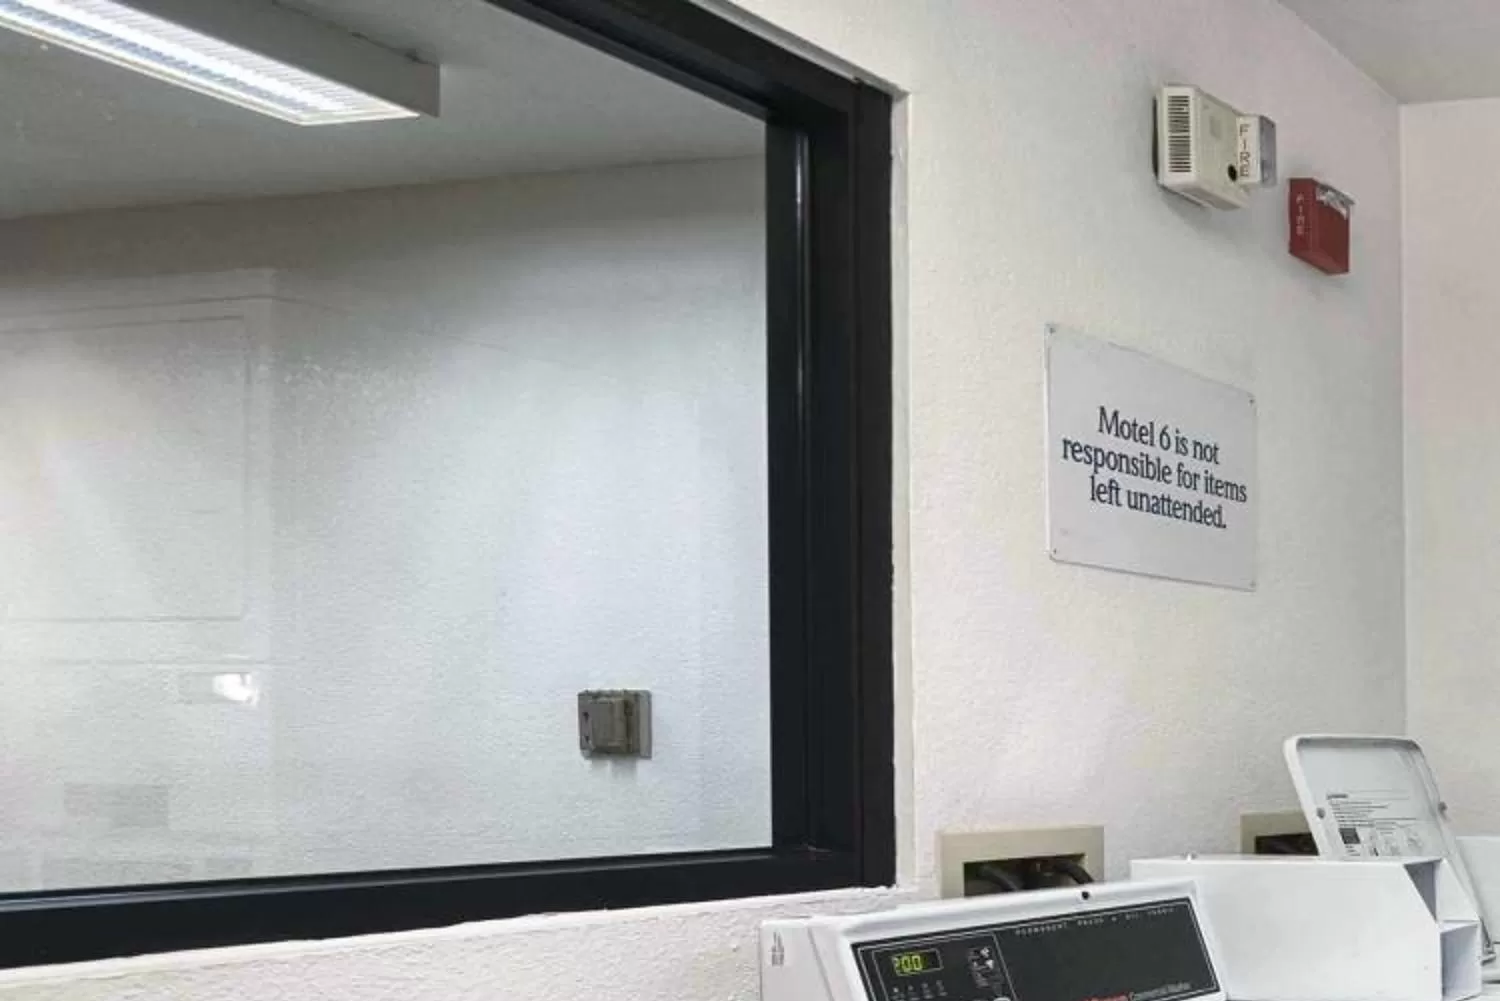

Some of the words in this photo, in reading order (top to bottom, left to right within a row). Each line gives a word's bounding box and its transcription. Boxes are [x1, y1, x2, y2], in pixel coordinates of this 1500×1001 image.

[1239, 123, 1250, 177] FIRE
[1098, 405, 1155, 447] Motel
[1159, 424, 1171, 451] 6
[1174, 428, 1189, 457] is
[1192, 438, 1220, 465] not
[1062, 438, 1173, 485] responsible
[1176, 461, 1201, 491] for
[1203, 469, 1248, 503] items
[1089, 474, 1123, 507] left
[1126, 488, 1227, 529] unattended.
